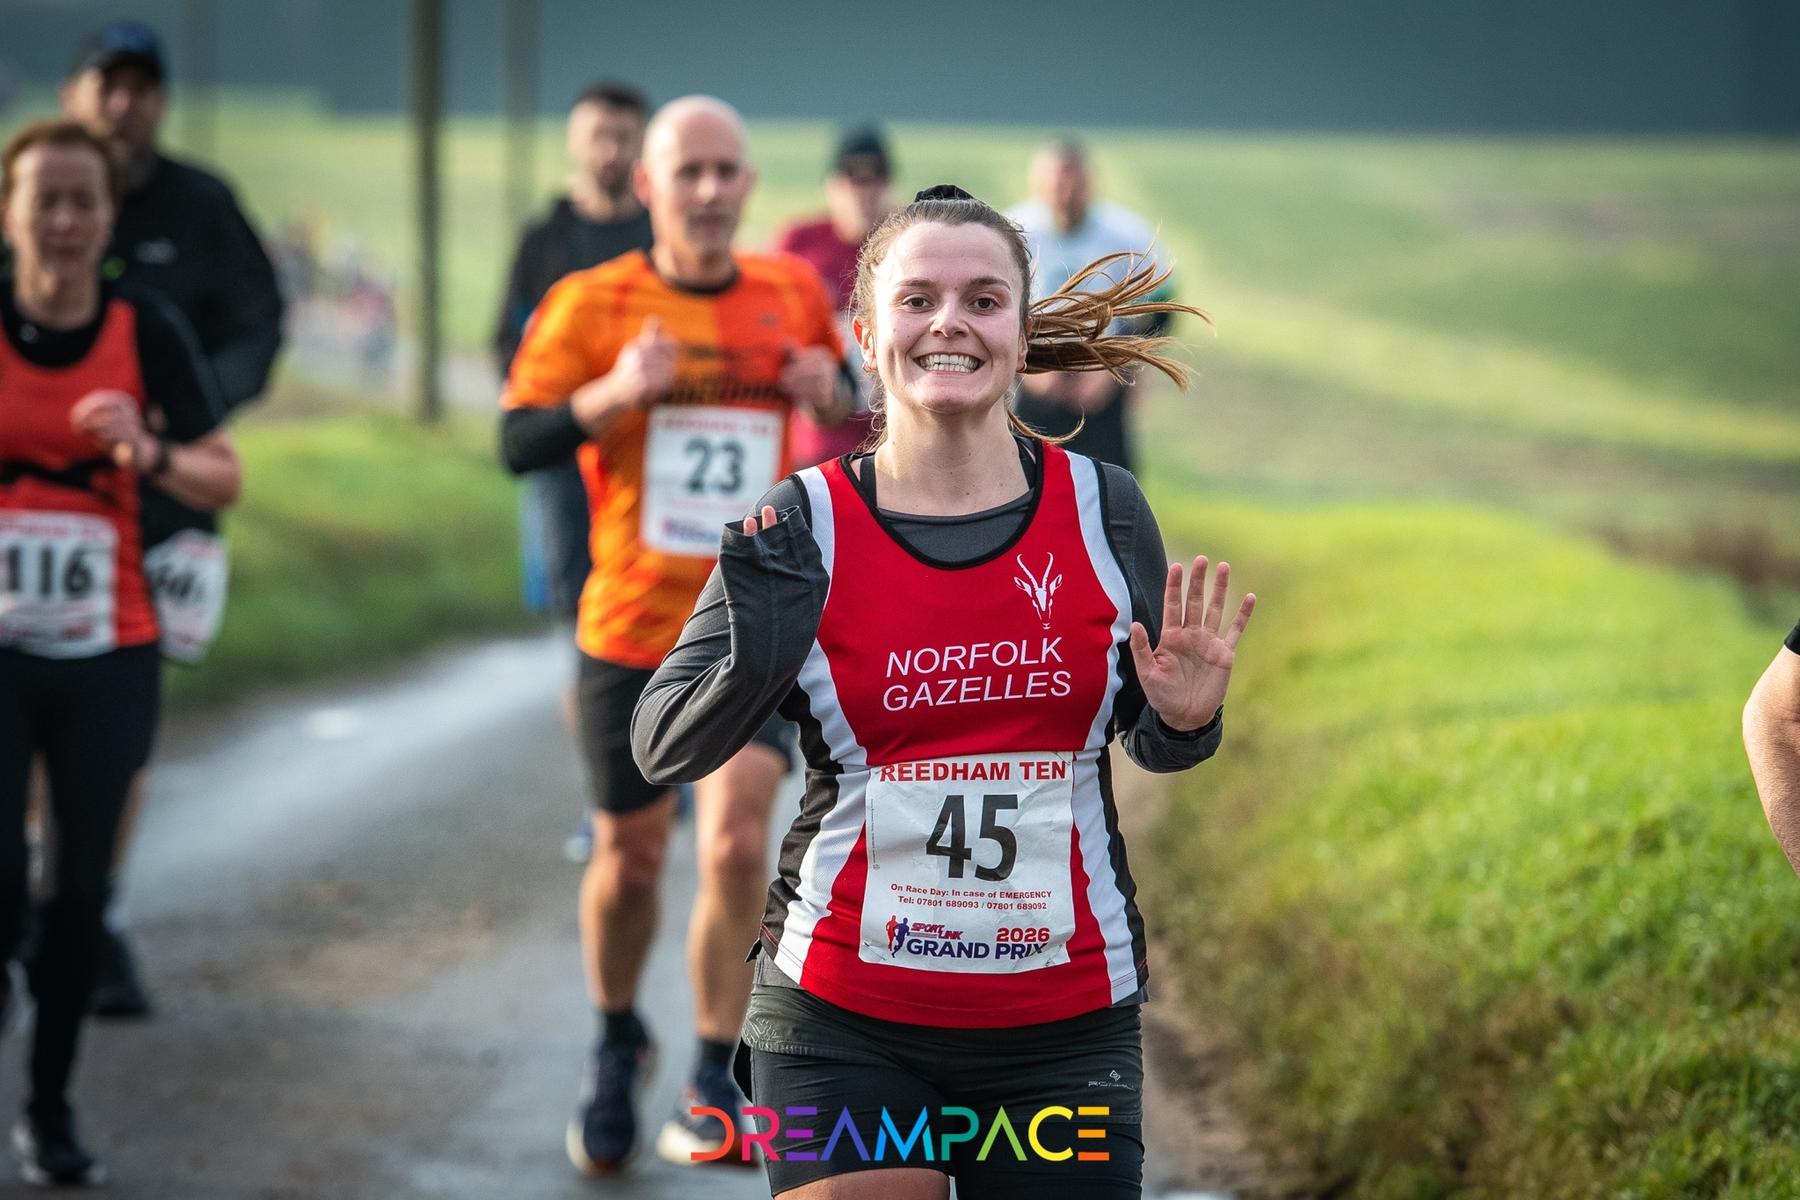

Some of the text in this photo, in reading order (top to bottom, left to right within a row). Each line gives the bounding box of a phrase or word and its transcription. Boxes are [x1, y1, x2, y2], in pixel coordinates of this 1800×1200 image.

[685, 437, 745, 494] 23
[7, 546, 93, 597] 116
[885, 636, 1063, 678] NORFOLK
[882, 670, 1072, 712] GAZELLES
[879, 760, 1067, 782] REEDHAM TEN
[926, 794, 1019, 882] 45
[890, 883, 903, 892] On
[905, 885, 928, 894] Race
[930, 888, 949, 897] Day:
[951, 889, 961, 897] In
[999, 891, 1052, 899] EMERGENCY
[898, 896, 915, 904] Tel:
[916, 898, 942, 907] 07801
[945, 900, 979, 909] 689093
[986, 902, 1014, 910] 07801
[1016, 902, 1047, 910] 689092
[906, 939, 1048, 960] GRAND PRIX
[996, 927, 1050, 942] 2026
